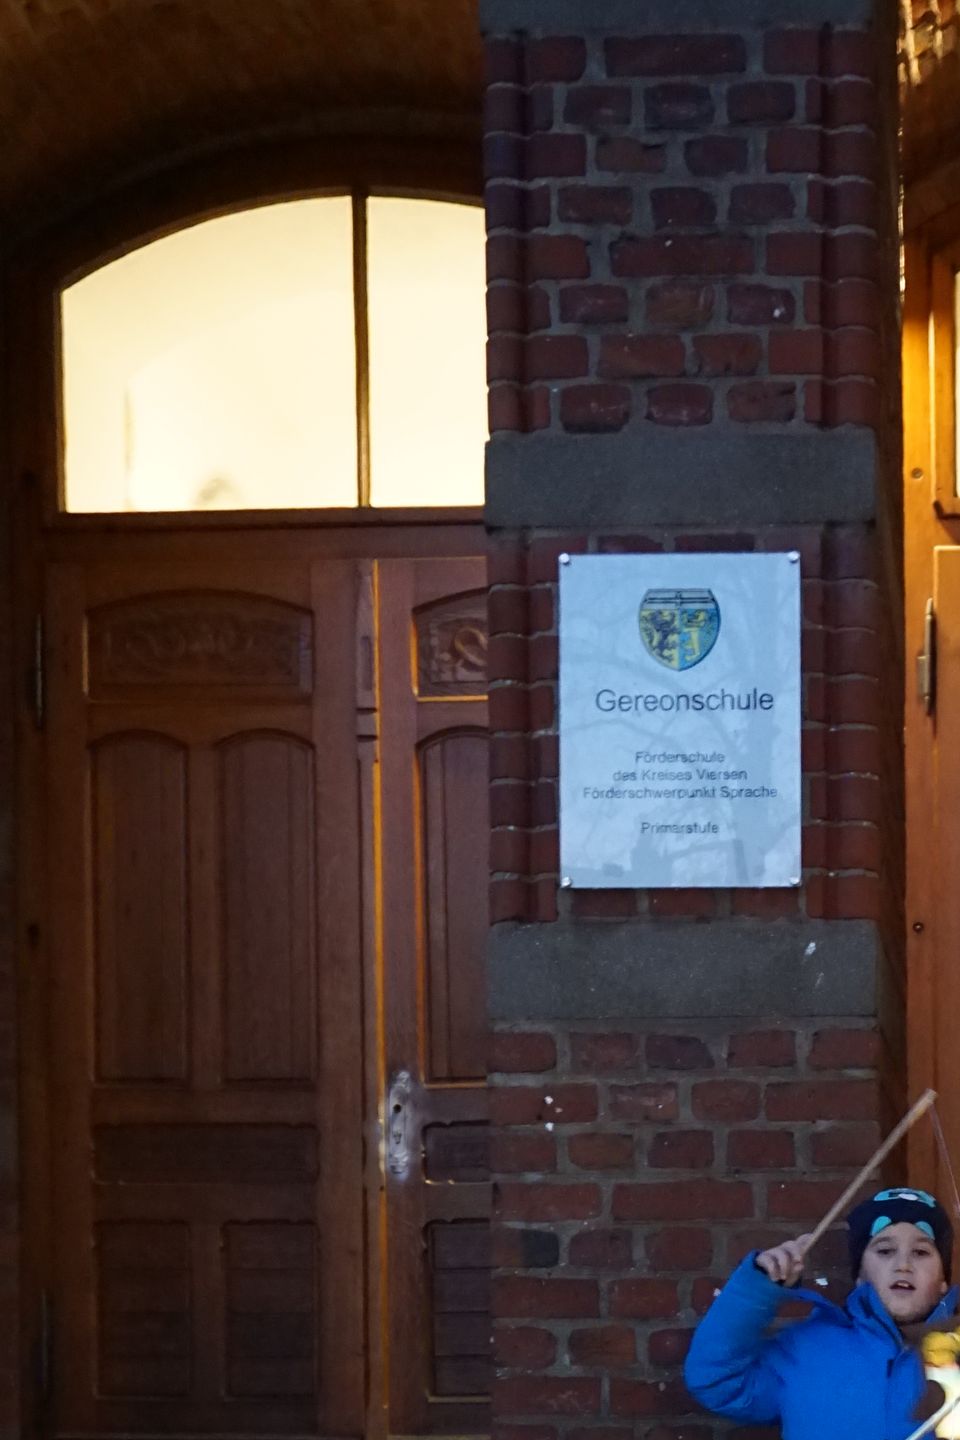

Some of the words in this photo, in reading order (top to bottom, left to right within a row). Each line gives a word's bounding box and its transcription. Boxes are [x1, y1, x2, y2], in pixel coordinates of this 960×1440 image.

[595, 687, 775, 713] Gereonschule
[635, 751, 726, 764] Förderschule
[612, 769, 637, 782] des
[642, 769, 692, 782] Kreises
[696, 769, 748, 782] Viersen
[583, 786, 717, 801] Förderschwerpunkt
[720, 786, 778, 801] Sprache
[641, 821, 720, 835] Primarstufe
